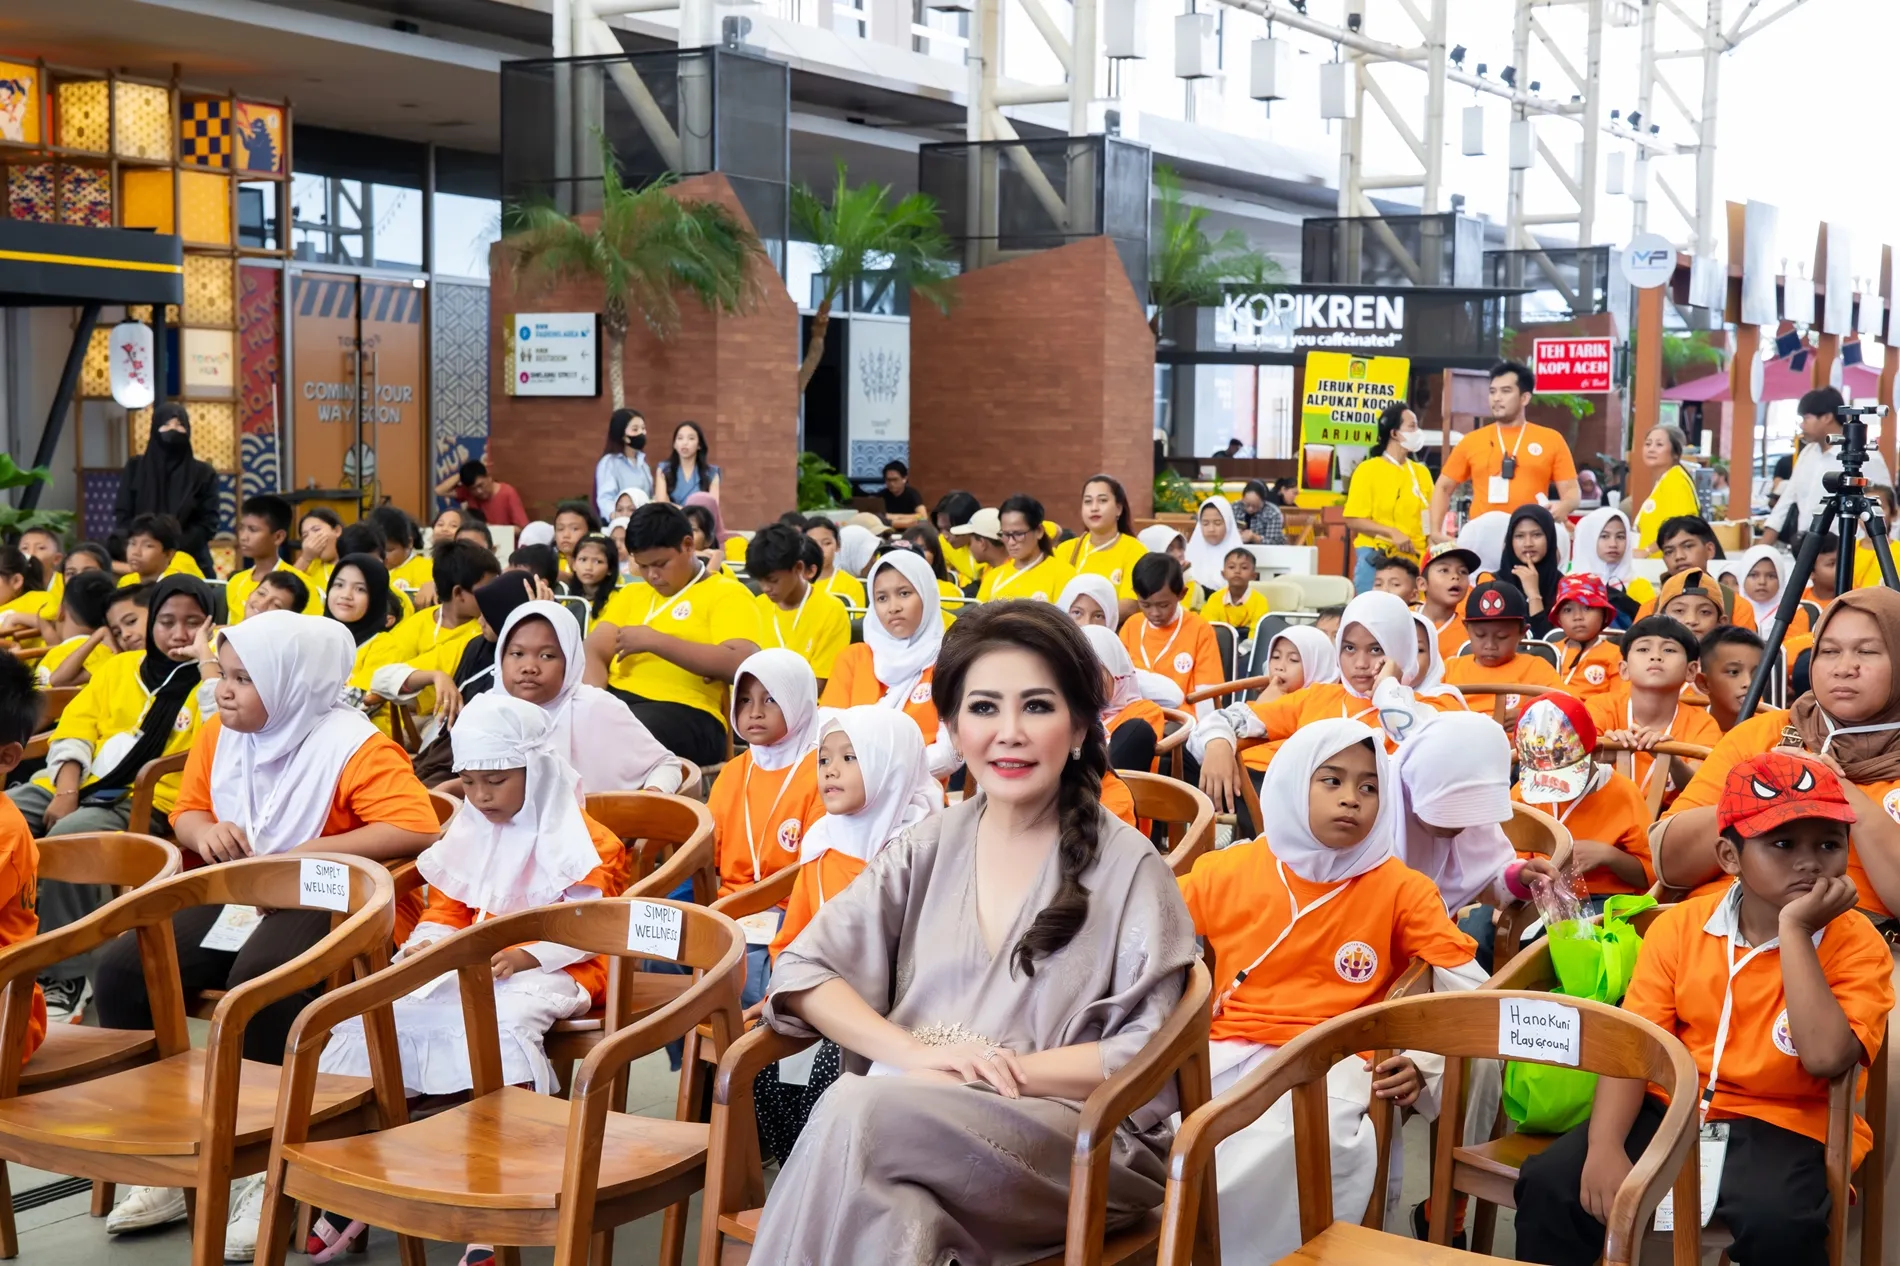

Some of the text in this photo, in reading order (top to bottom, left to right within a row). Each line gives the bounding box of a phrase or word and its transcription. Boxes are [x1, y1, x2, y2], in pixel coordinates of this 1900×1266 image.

[1224, 293, 1404, 329] KOPIKREN
[1291, 334, 1316, 349] you
[1540, 343, 1608, 359] TEH TARIK
[1538, 361, 1608, 374] KOPI ACEH
[304, 381, 413, 403] COMING YOUR
[1318, 380, 1395, 396] JERUK PERAS
[1306, 394, 1358, 408] ALPUKAT
[318, 404, 354, 423] WAY
[1331, 410, 1376, 424] CENDOL
[1321, 428, 1380, 442] ARJUN
[315, 864, 341, 880] SIMPLY
[303, 881, 345, 897] WELLNESS
[643, 904, 677, 923] SIMPLY
[634, 923, 678, 941] WELLNESS
